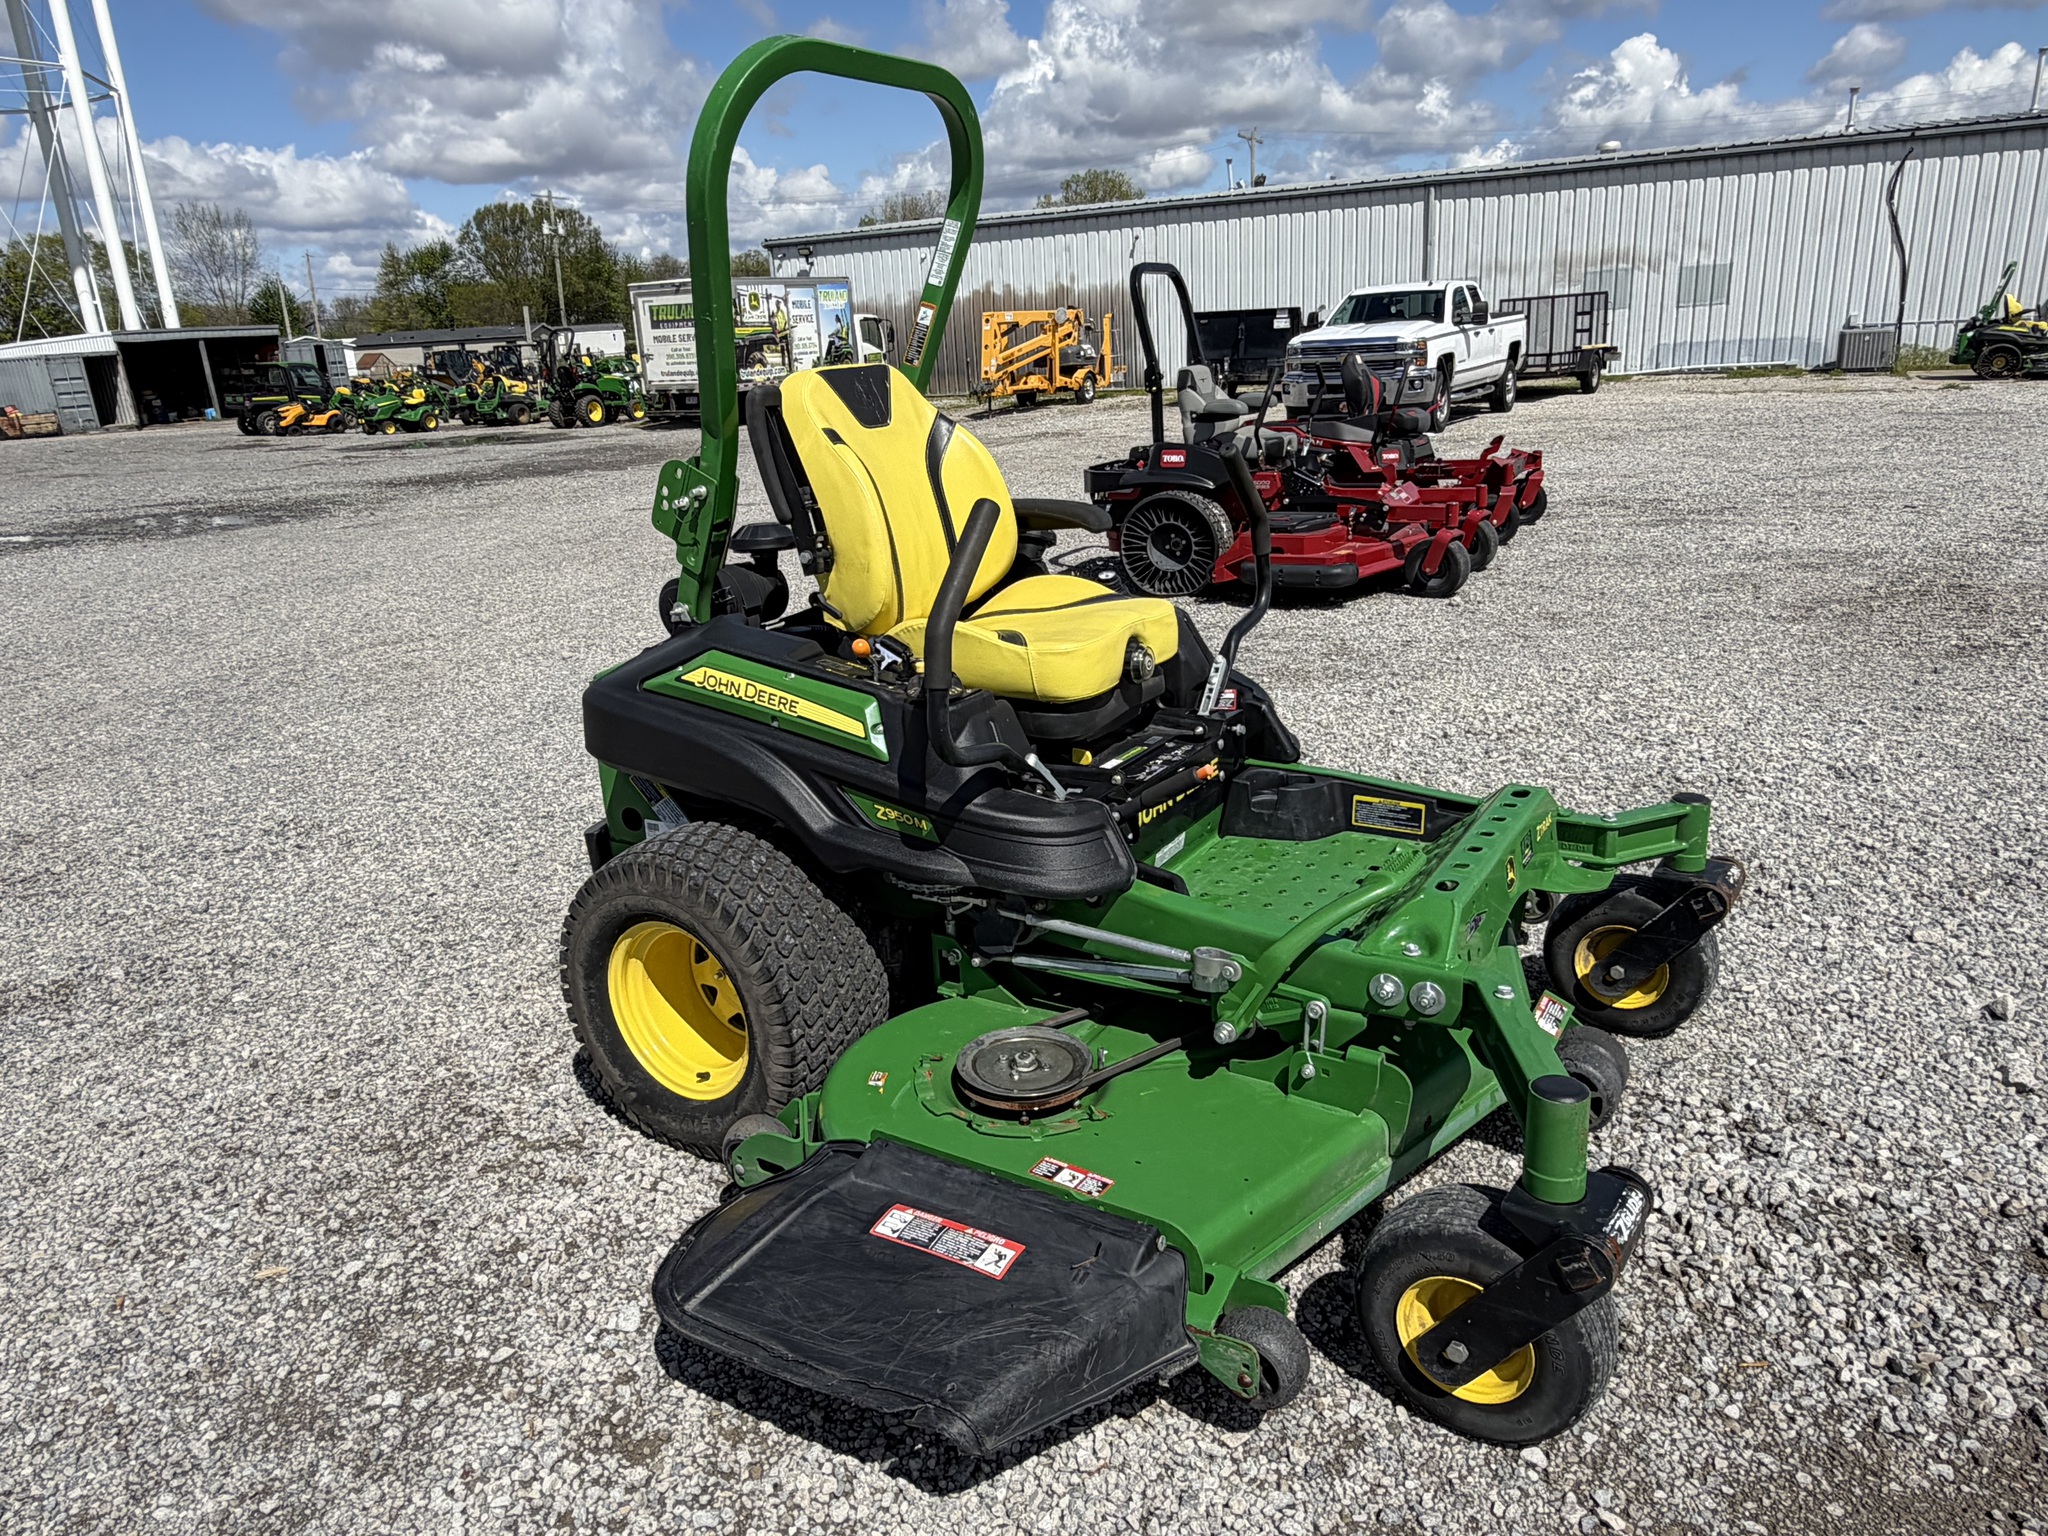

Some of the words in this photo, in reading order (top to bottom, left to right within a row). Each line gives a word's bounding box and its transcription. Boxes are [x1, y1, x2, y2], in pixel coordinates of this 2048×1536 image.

[792, 300, 812, 310] MOBILE
[652, 304, 695, 321] TRULAN
[792, 314, 815, 324] SERVICE
[653, 334, 678, 344] MOBILE
[661, 369, 697, 378] trulandequip.
[1161, 454, 1185, 463] TORO
[697, 670, 742, 696] JOHN
[744, 682, 800, 715] DEERE
[914, 1209, 943, 1224] DANGER
[973, 1228, 1006, 1246] PELIGRO
